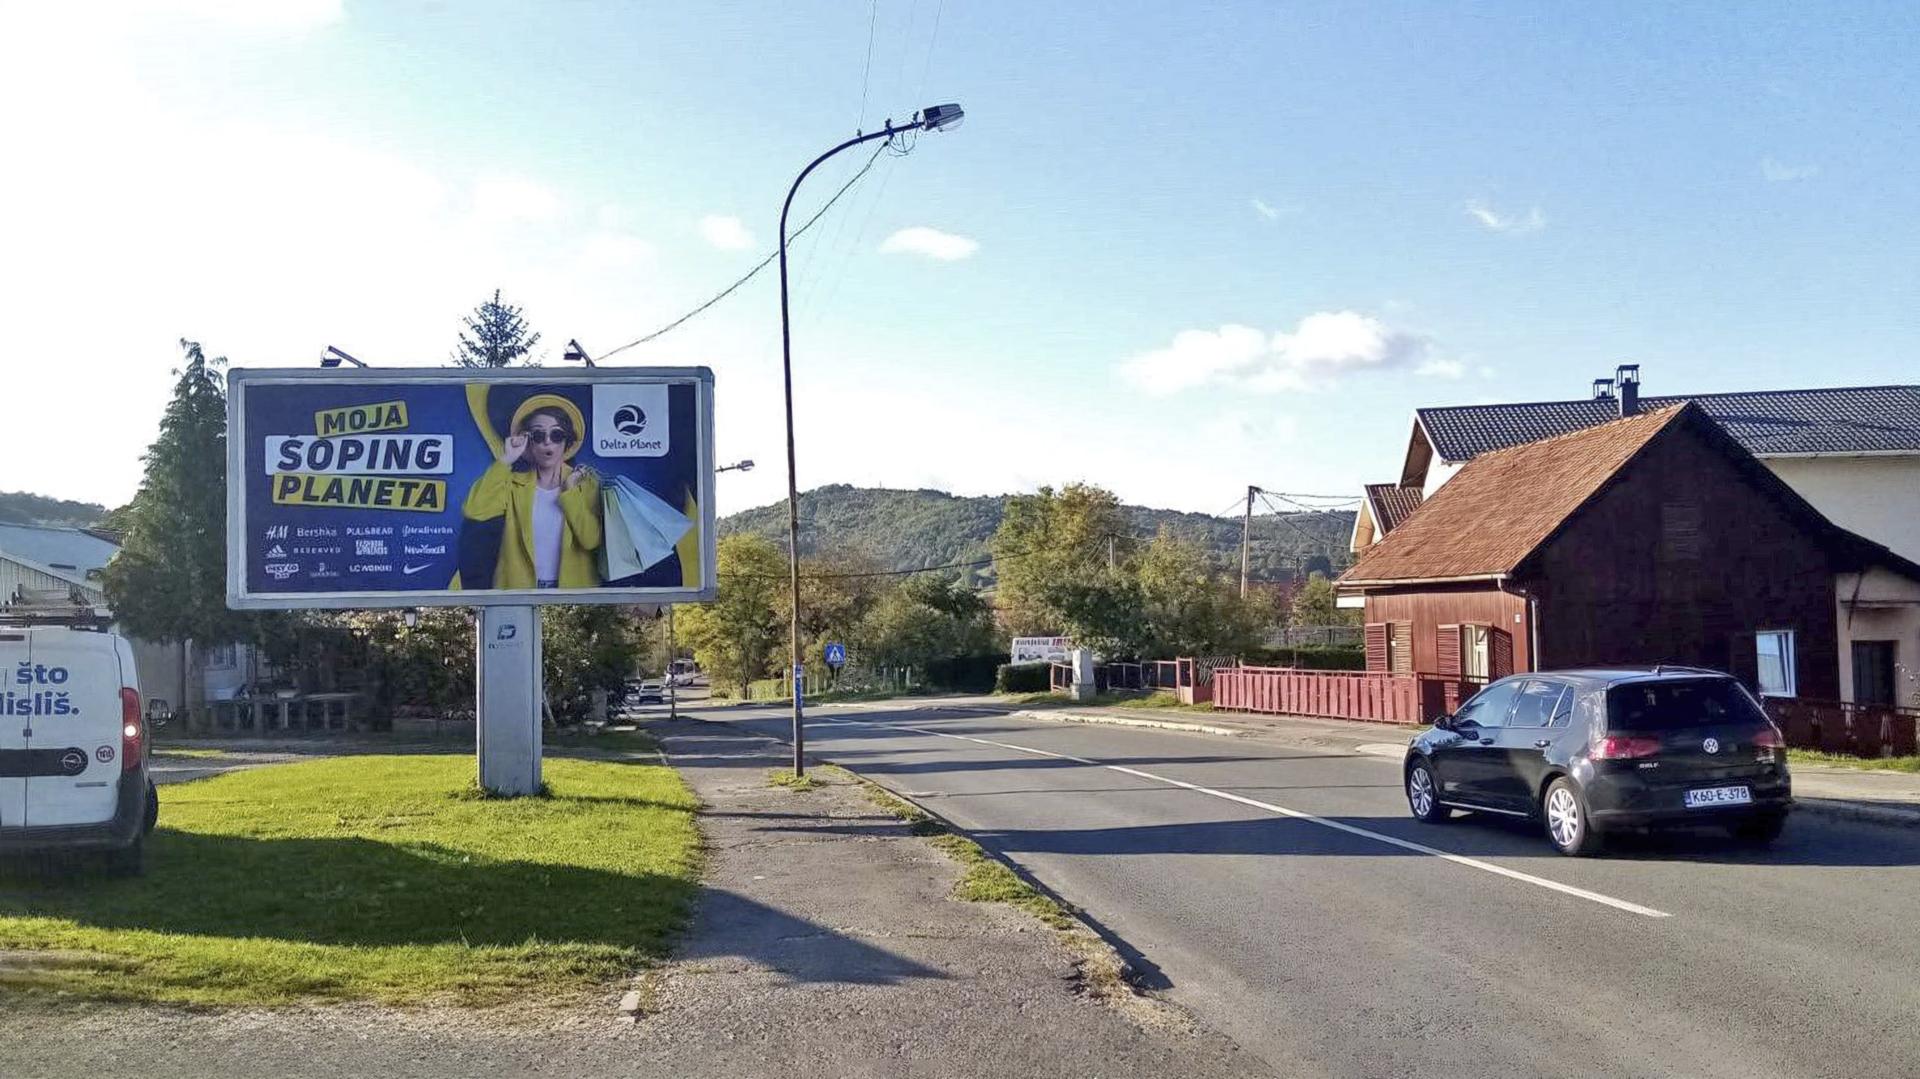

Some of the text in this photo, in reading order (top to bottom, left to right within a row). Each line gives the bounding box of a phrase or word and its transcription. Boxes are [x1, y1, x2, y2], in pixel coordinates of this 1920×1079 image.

[323, 405, 402, 435] MOJA
[600, 438, 662, 450] Delta Planet
[278, 475, 438, 508] PLANETA
[16, 661, 69, 685] što
[0, 691, 80, 716] isliš.
